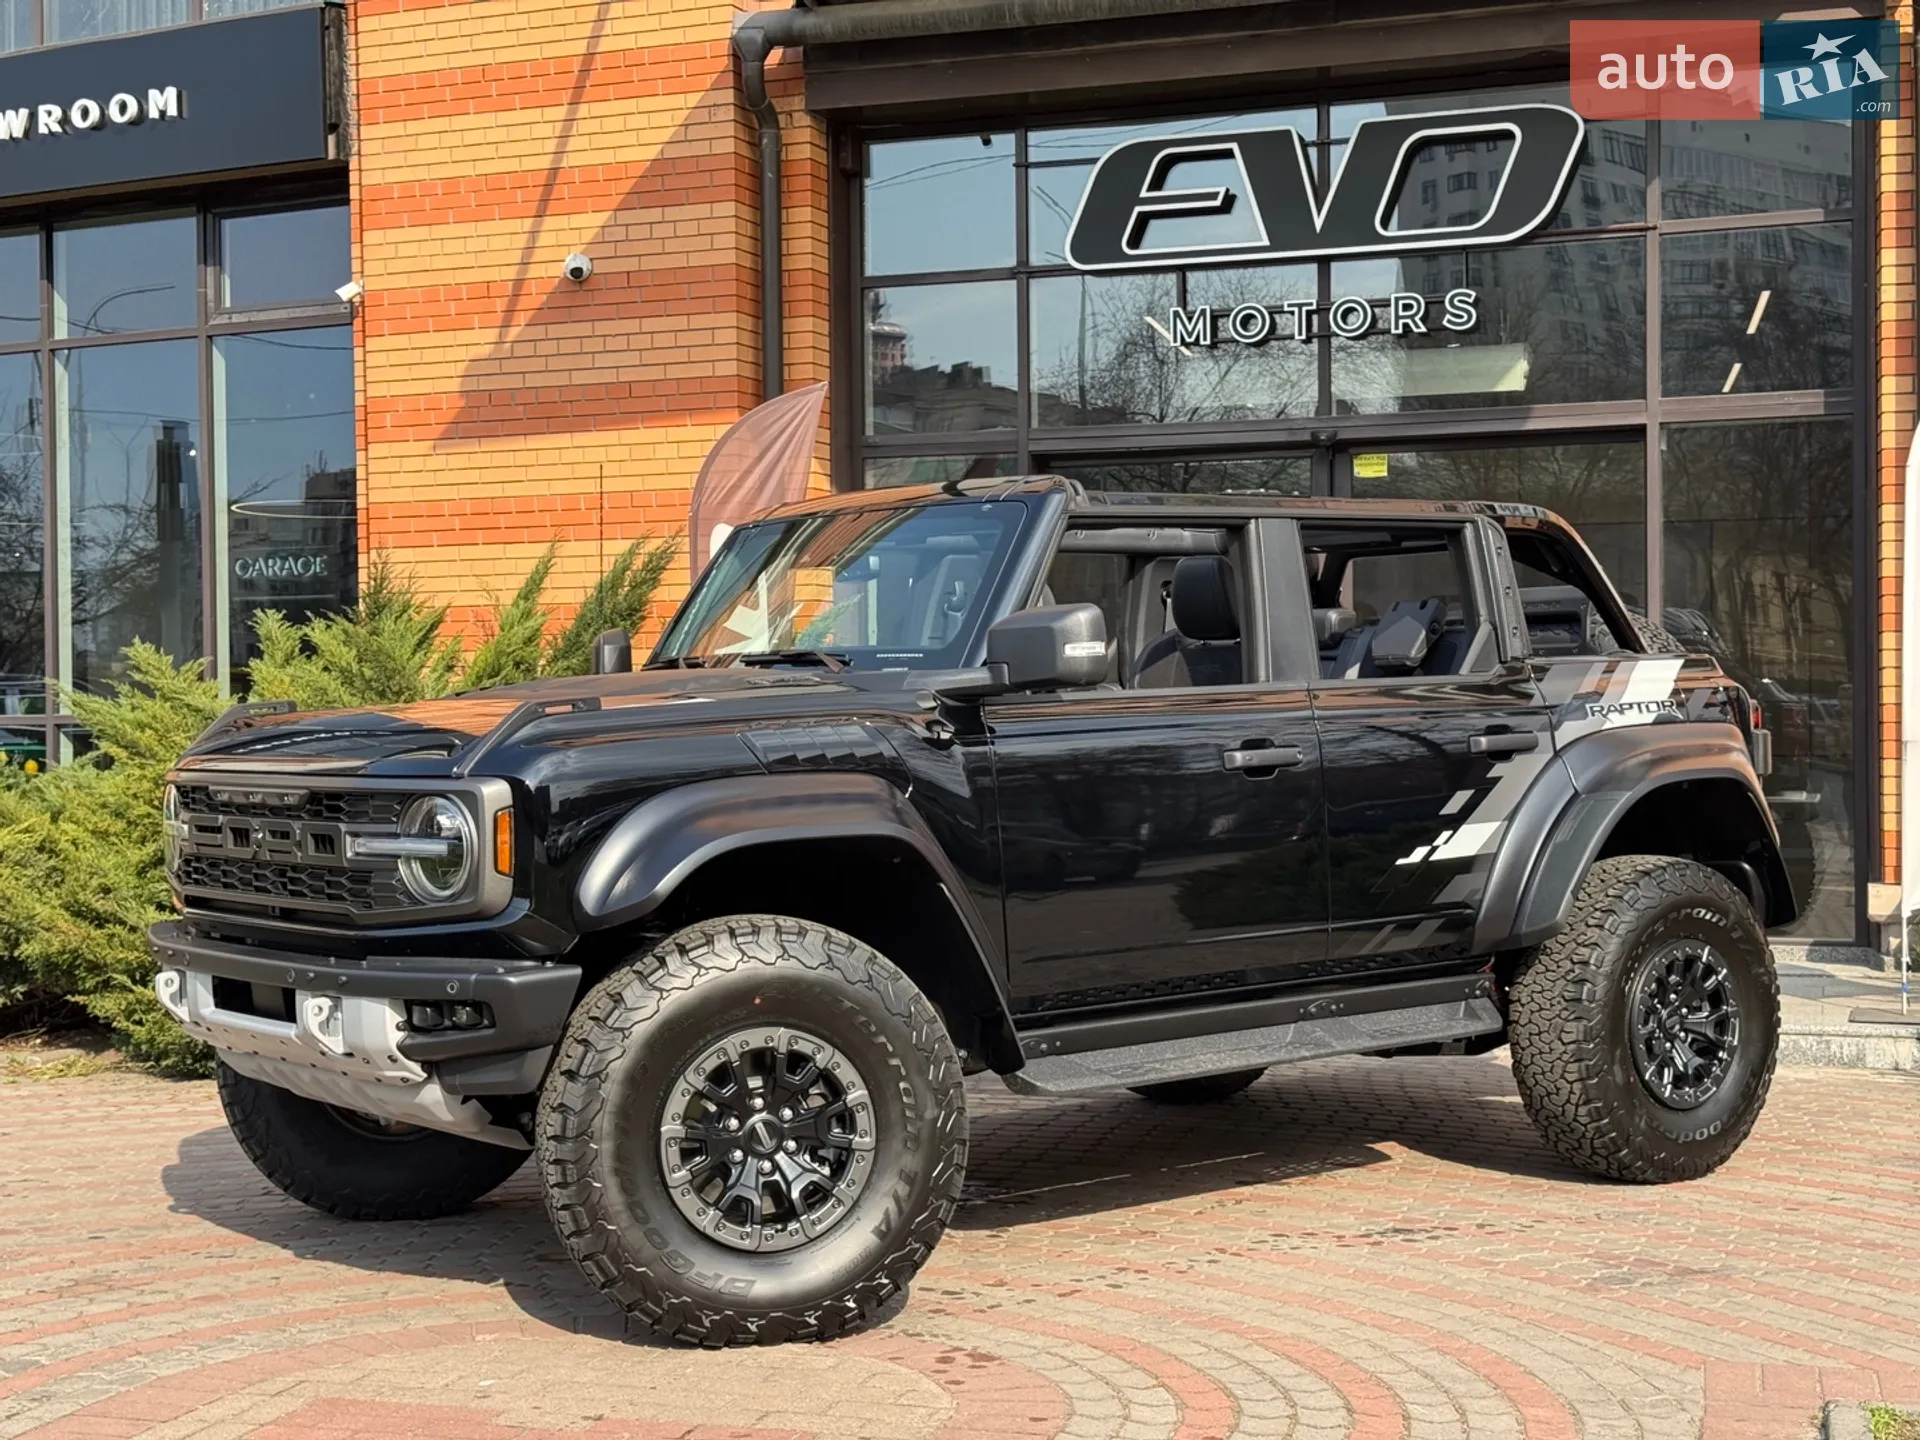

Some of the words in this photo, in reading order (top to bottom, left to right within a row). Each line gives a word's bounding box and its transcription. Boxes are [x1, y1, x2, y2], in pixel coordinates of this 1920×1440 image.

[0, 86, 180, 140] WROOM
[1064, 103, 1585, 271] EVO
[1169, 288, 1478, 348] MOTORS
[234, 555, 328, 579] GARAGE
[1585, 699, 1684, 724] RAPTOR
